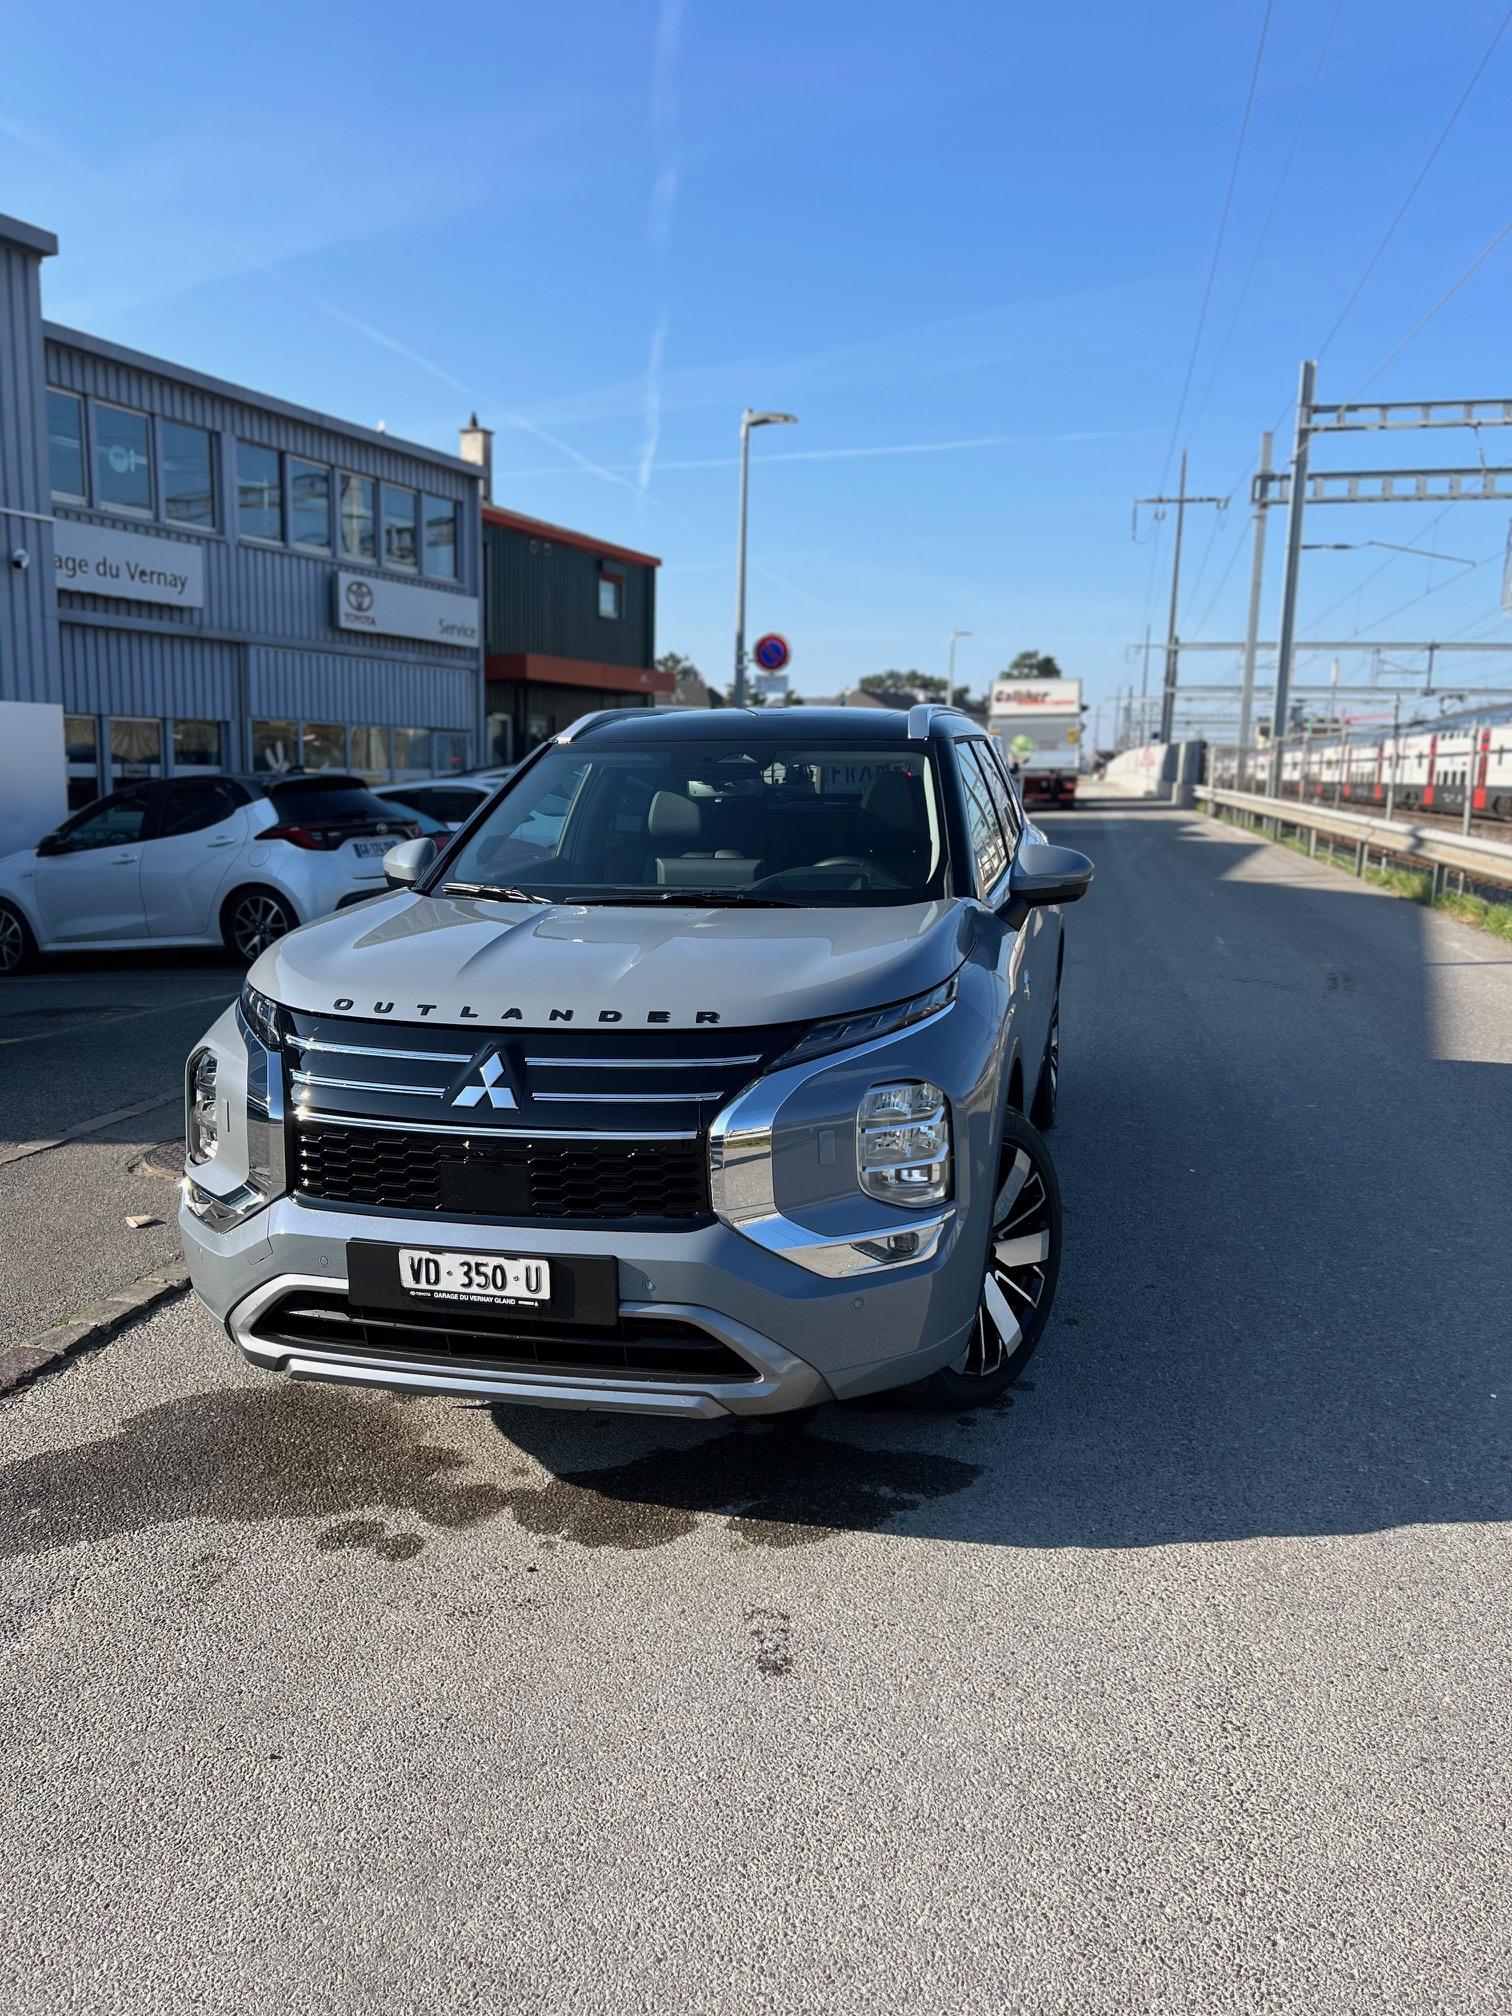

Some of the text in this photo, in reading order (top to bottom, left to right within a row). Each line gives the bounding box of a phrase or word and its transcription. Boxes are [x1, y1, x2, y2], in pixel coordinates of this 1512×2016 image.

[96, 556, 120, 579] du
[125, 560, 188, 595] Vernay
[343, 612, 376, 626] TOYOTA
[439, 618, 478, 639] Service
[333, 998, 722, 1025] OUTLANDER
[408, 1256, 542, 1294] VD 350 U
[433, 1292, 459, 1301] GARAGE
[469, 1295, 494, 1303] VERNAY
[494, 1296, 516, 1305] GLAND
